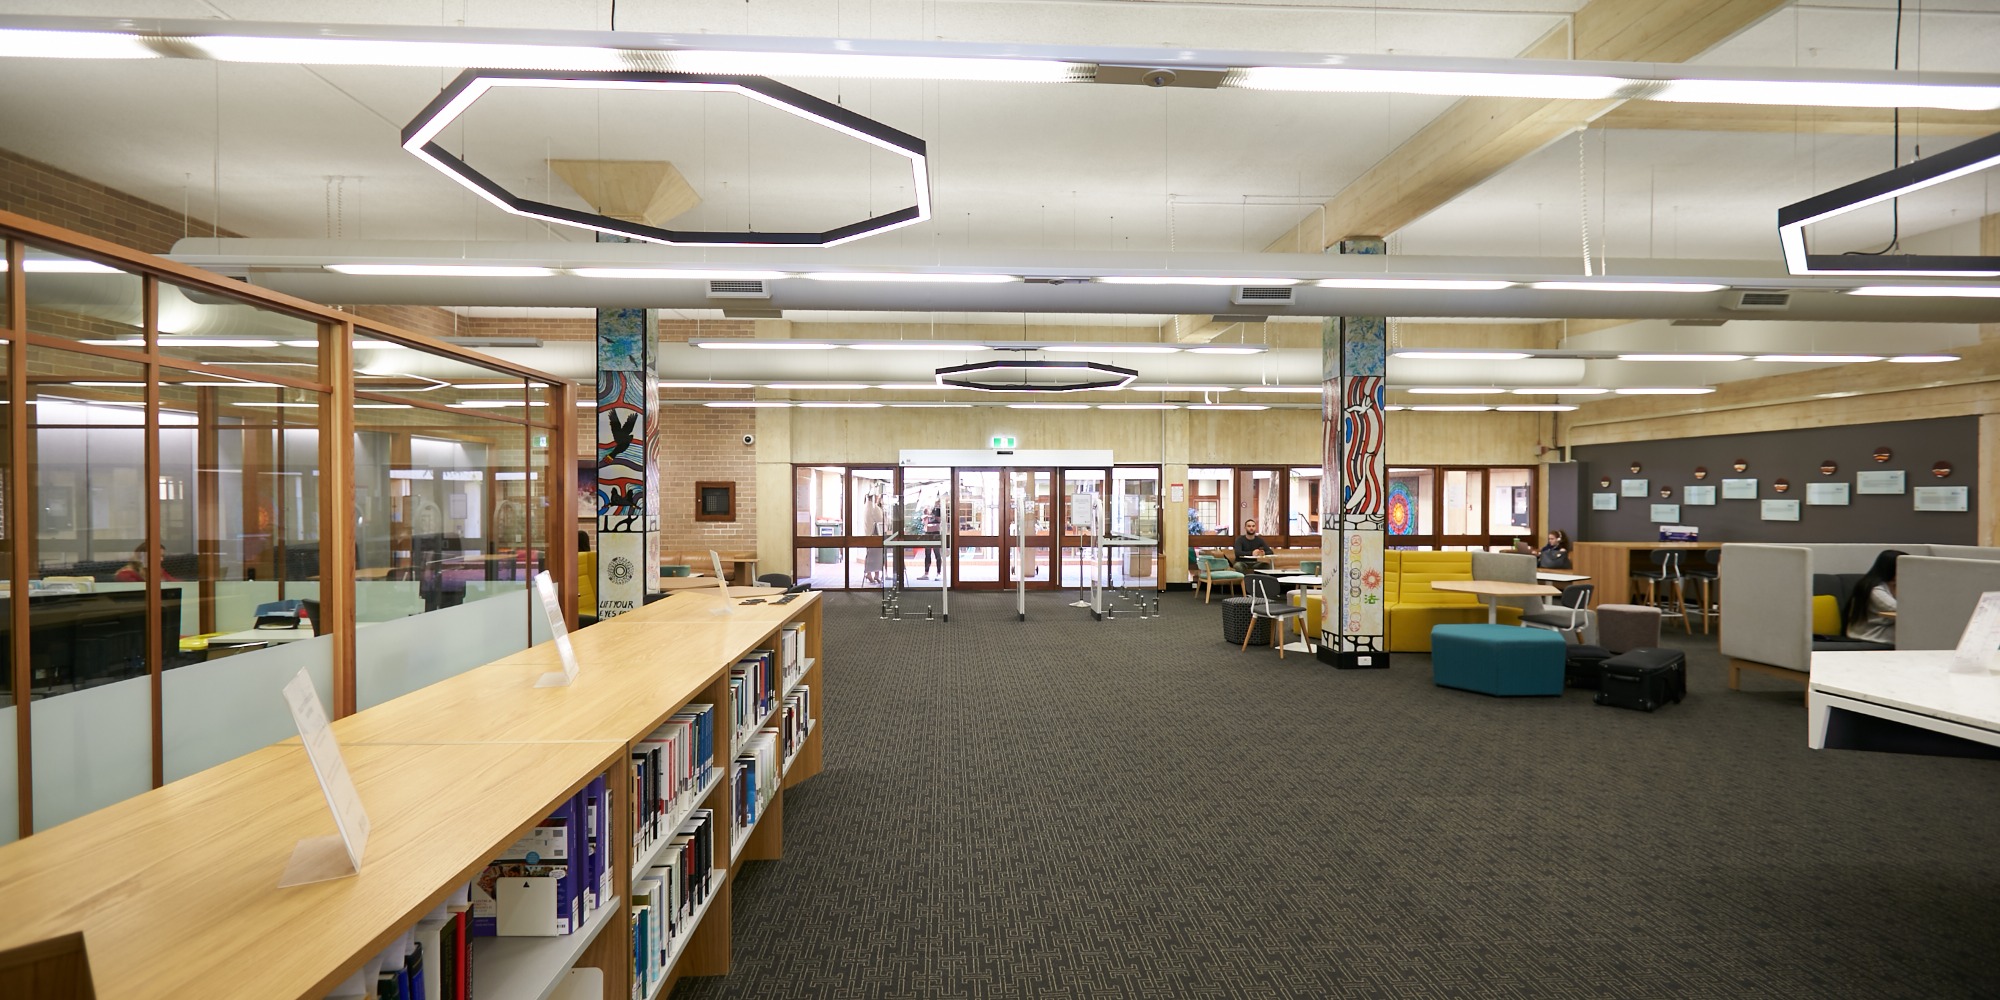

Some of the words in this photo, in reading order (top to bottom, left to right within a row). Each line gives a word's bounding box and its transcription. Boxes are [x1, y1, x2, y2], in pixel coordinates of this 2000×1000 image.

[600, 600, 613, 608] LIFT
[613, 600, 634, 609] YOUR
[599, 610, 617, 618] EYES
